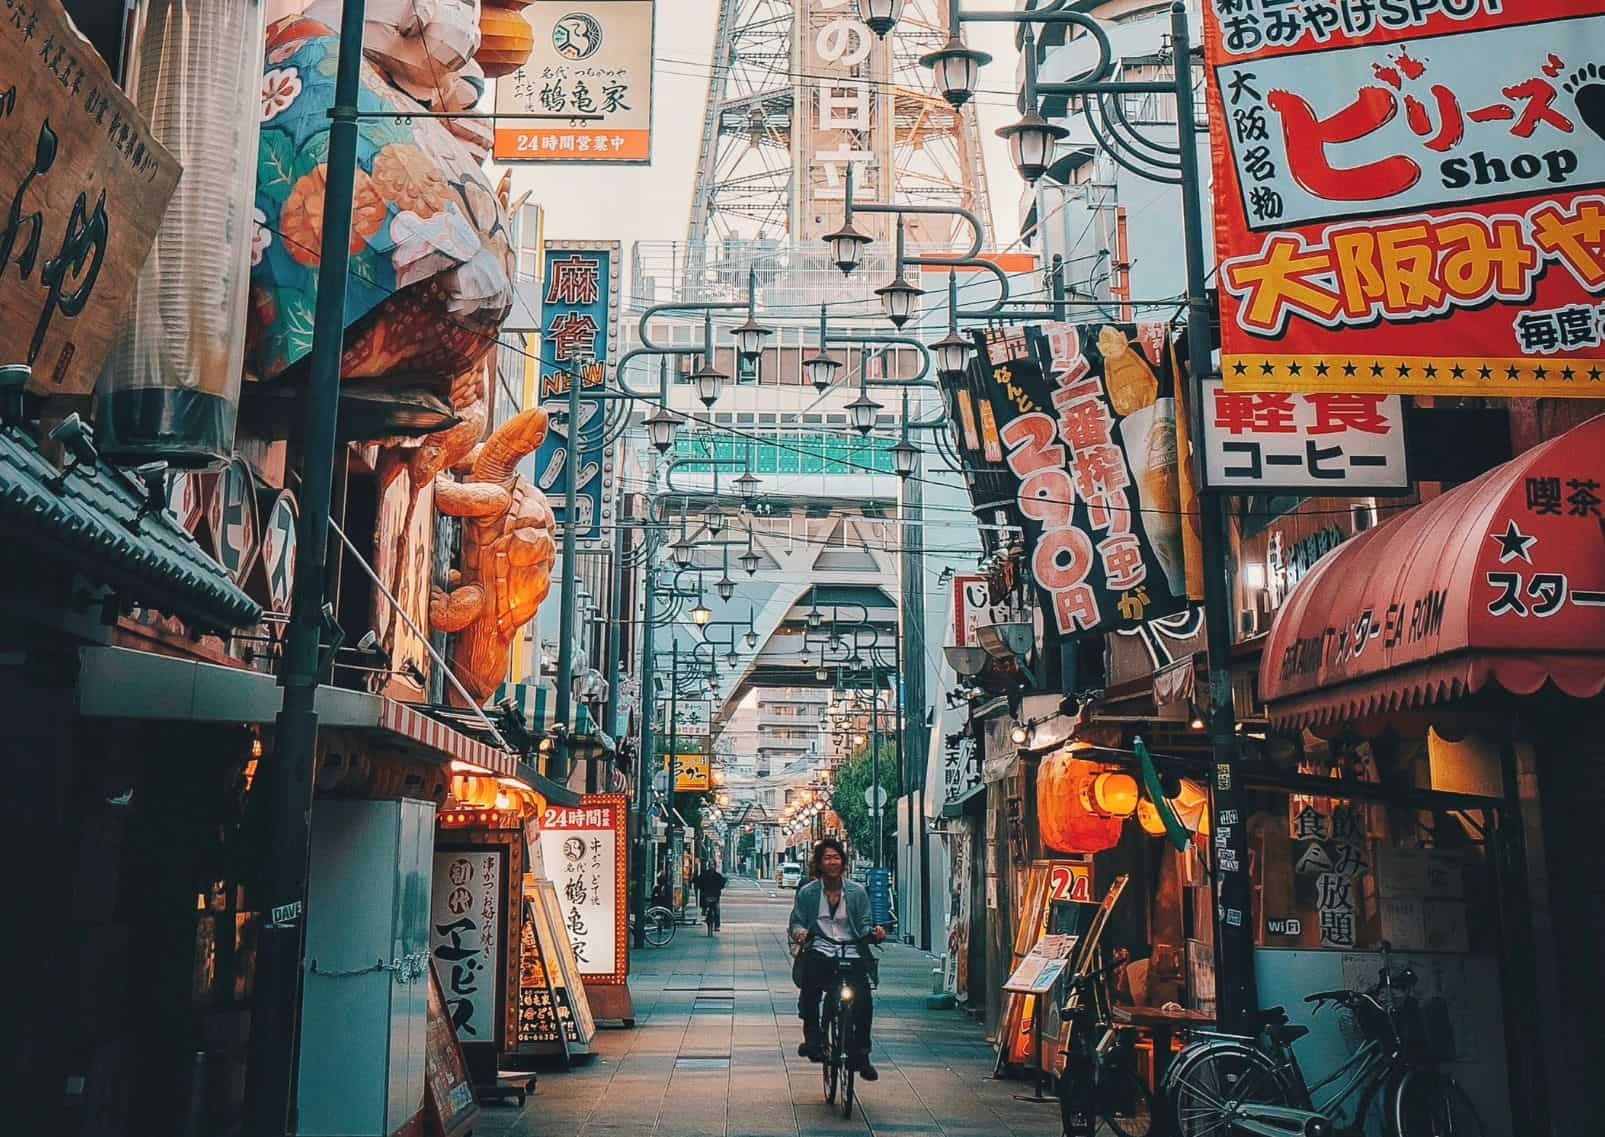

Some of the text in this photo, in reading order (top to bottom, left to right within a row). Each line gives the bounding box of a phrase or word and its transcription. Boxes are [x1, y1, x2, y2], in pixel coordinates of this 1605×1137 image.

[541, 79, 632, 113] 鶴亀家
[517, 135, 625, 151] 24時間営業中
[1228, 70, 1283, 220] 大阪名物
[1267, 44, 1574, 201] ビリーズ
[1440, 148, 1578, 189] shop
[546, 254, 600, 362] 麻雀
[1517, 307, 1605, 351] 毎度
[541, 361, 605, 397] NEW
[1213, 389, 1392, 435] 軽食
[1222, 439, 1387, 480] コーヒー
[1525, 475, 1602, 517] 喫茶
[1001, 413, 1101, 635] 290円
[1486, 571, 1605, 618] スター
[1051, 866, 1089, 902] 24
[1317, 873, 1354, 946] 放題
[433, 917, 483, 1037] エビス
